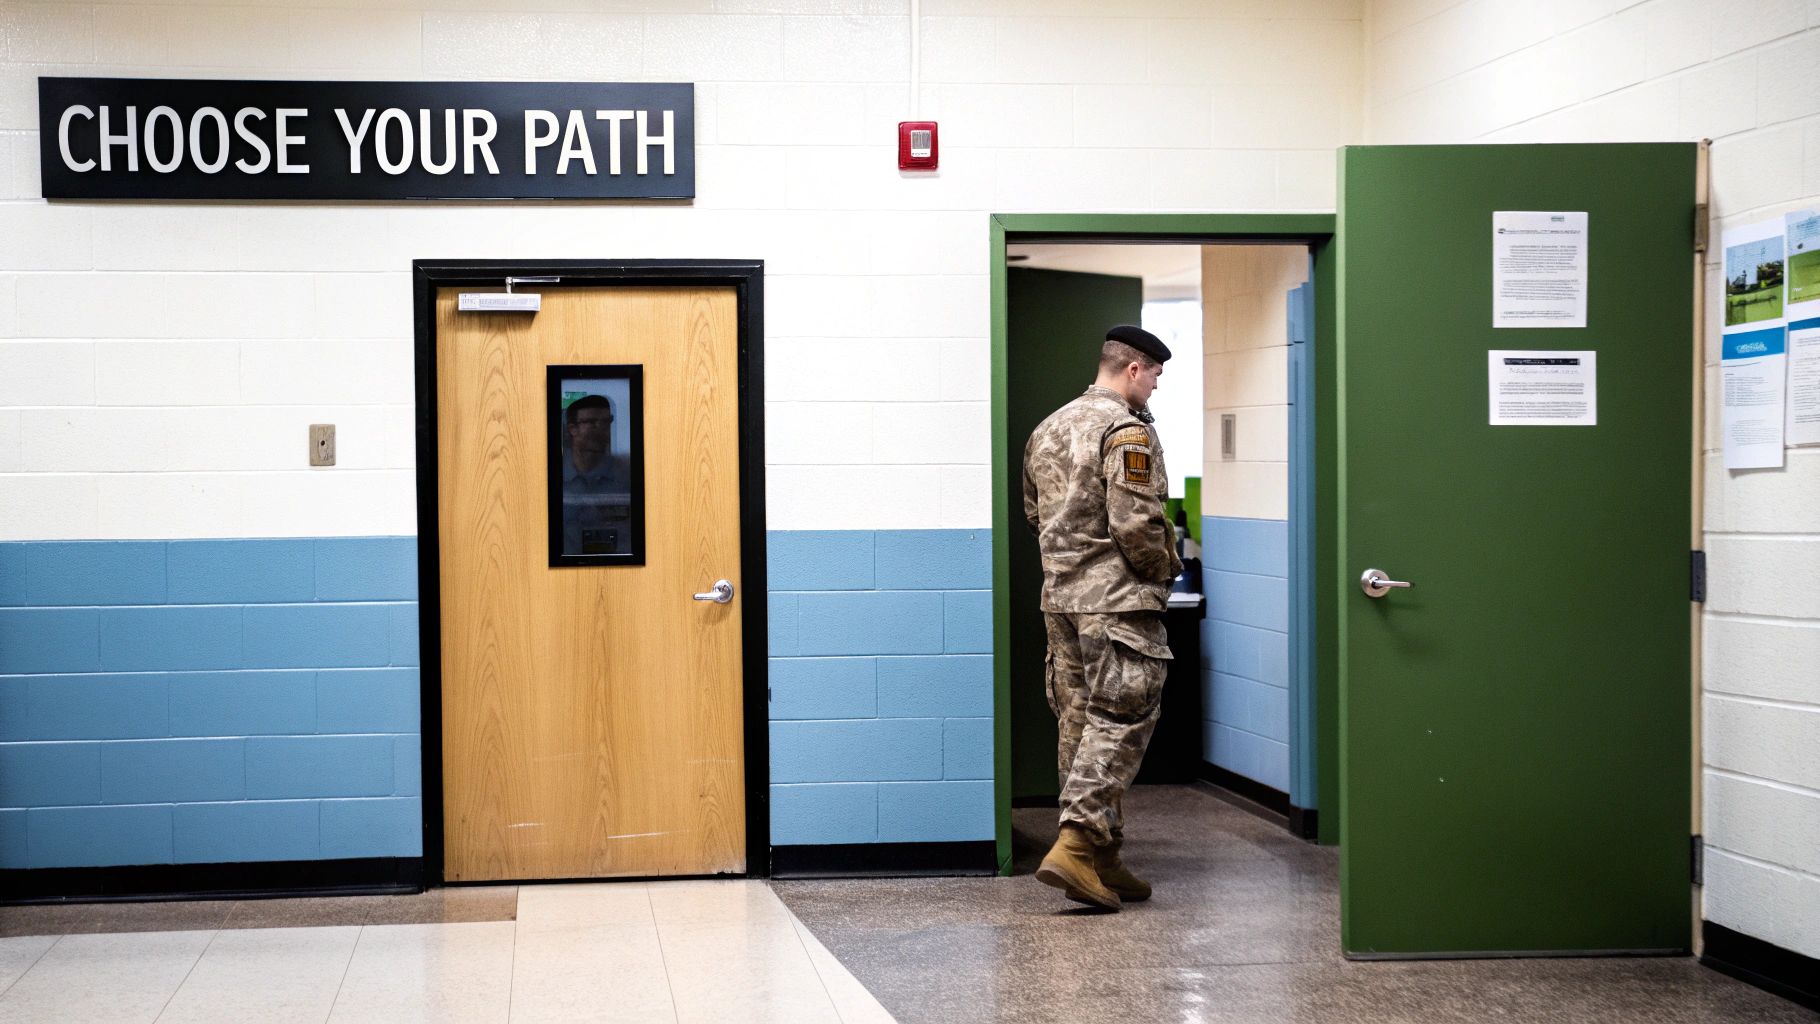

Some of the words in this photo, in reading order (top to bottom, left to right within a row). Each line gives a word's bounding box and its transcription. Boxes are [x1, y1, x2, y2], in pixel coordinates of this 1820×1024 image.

[58, 104, 310, 174] CHOOSE
[333, 108, 501, 175] YOUR
[524, 109, 676, 175] PATH
